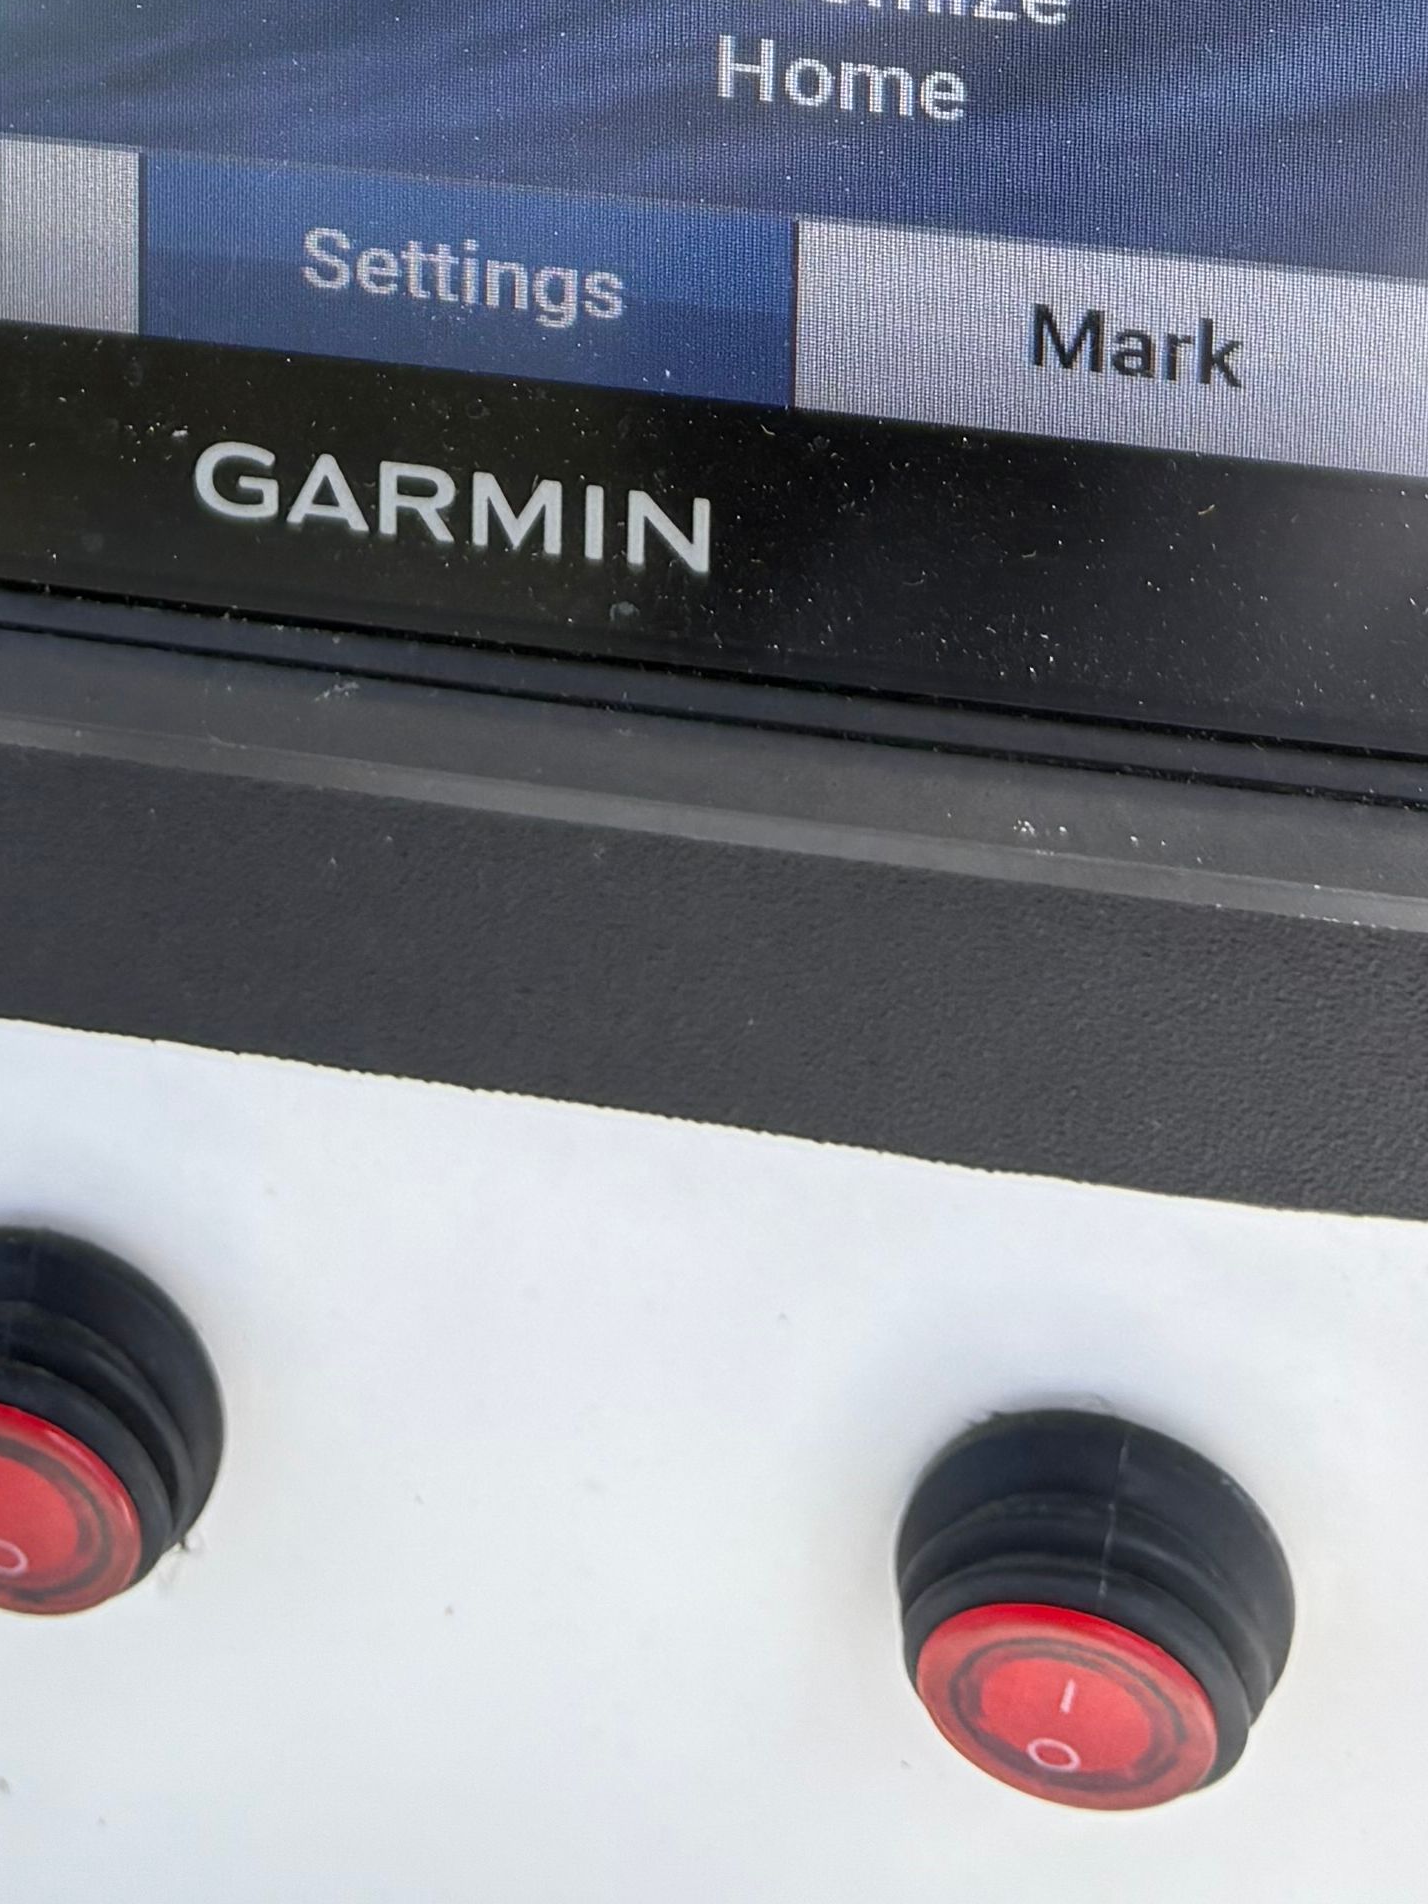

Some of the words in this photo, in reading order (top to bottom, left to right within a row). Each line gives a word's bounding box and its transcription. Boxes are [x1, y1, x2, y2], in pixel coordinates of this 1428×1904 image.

[716, 34, 968, 123] Home
[300, 226, 626, 328] Settings
[1031, 303, 1244, 389] Mark
[194, 441, 711, 575] GARMIN
